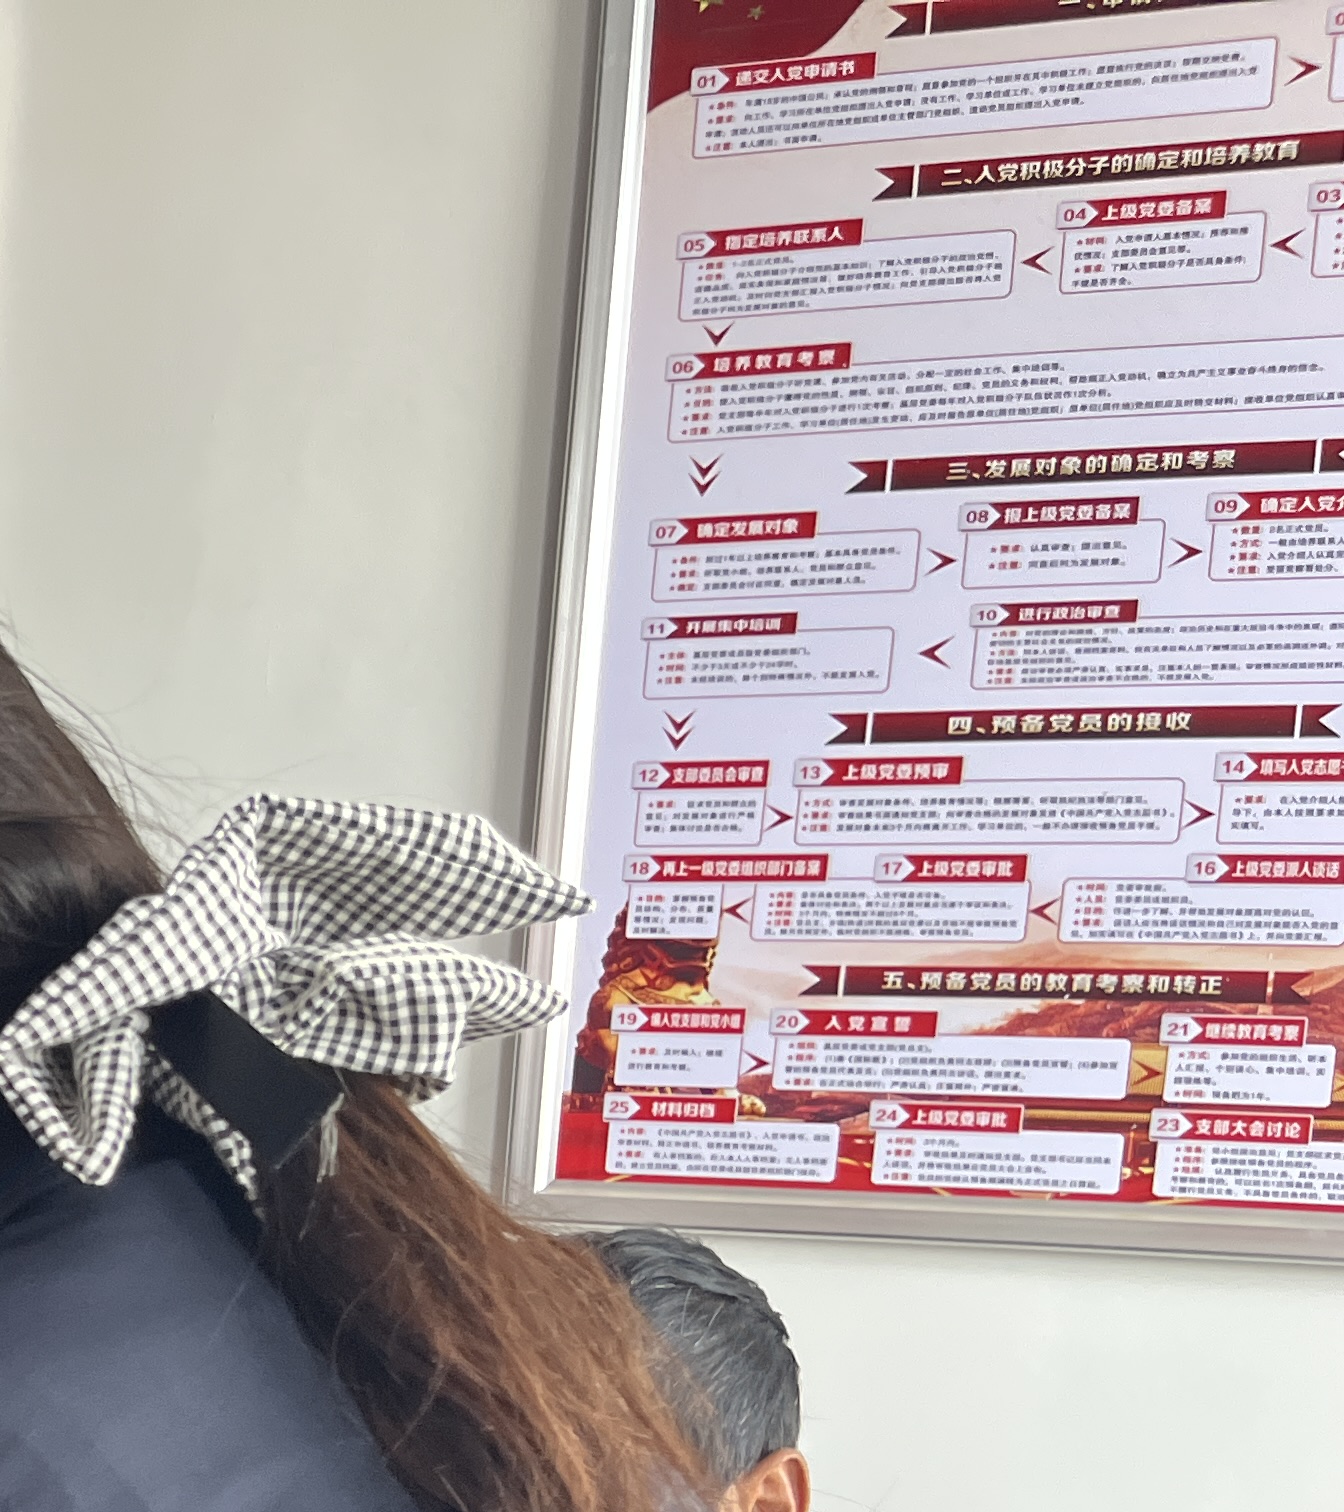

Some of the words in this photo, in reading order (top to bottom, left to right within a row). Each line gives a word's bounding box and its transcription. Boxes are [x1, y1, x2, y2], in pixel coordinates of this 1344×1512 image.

[1316, 189, 1341, 204] 03
[1101, 197, 1212, 221] 上级党委备案
[946, 450, 1237, 482] 三、发展对象的确定和考察
[946, 711, 1192, 736] 四、预备党员的接收
[883, 968, 1222, 997] 五、预备党员的教育考察和转正
[1194, 1118, 1301, 1139] 支部大会讨论
